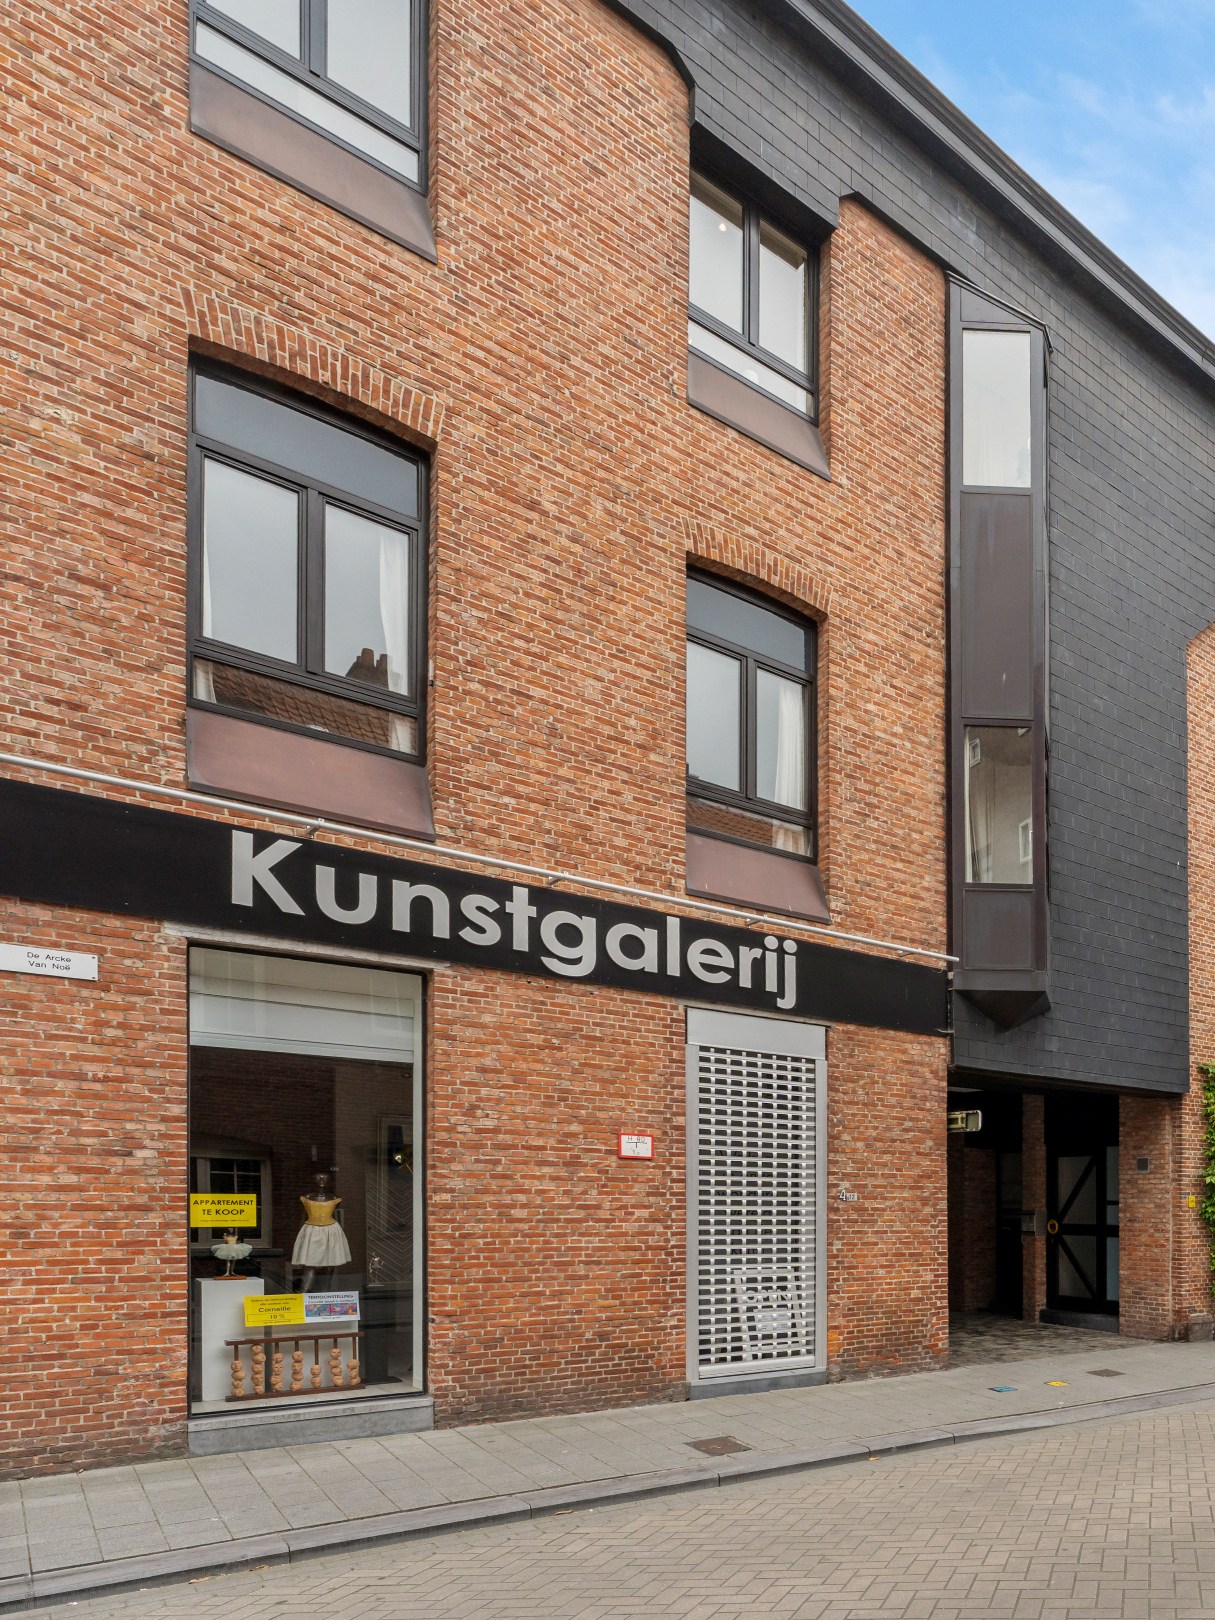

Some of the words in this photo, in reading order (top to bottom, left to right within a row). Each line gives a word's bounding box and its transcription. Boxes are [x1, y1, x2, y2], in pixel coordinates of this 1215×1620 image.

[230, 828, 798, 1009] Kunstgalerij
[26, 951, 40, 959] De
[45, 954, 72, 963] Arcke
[28, 960, 47, 968] Van
[52, 963, 71, 971] Noë
[839, 1189, 847, 1201] 4
[201, 1208, 212, 1216] TE
[215, 1208, 245, 1216] KOOP
